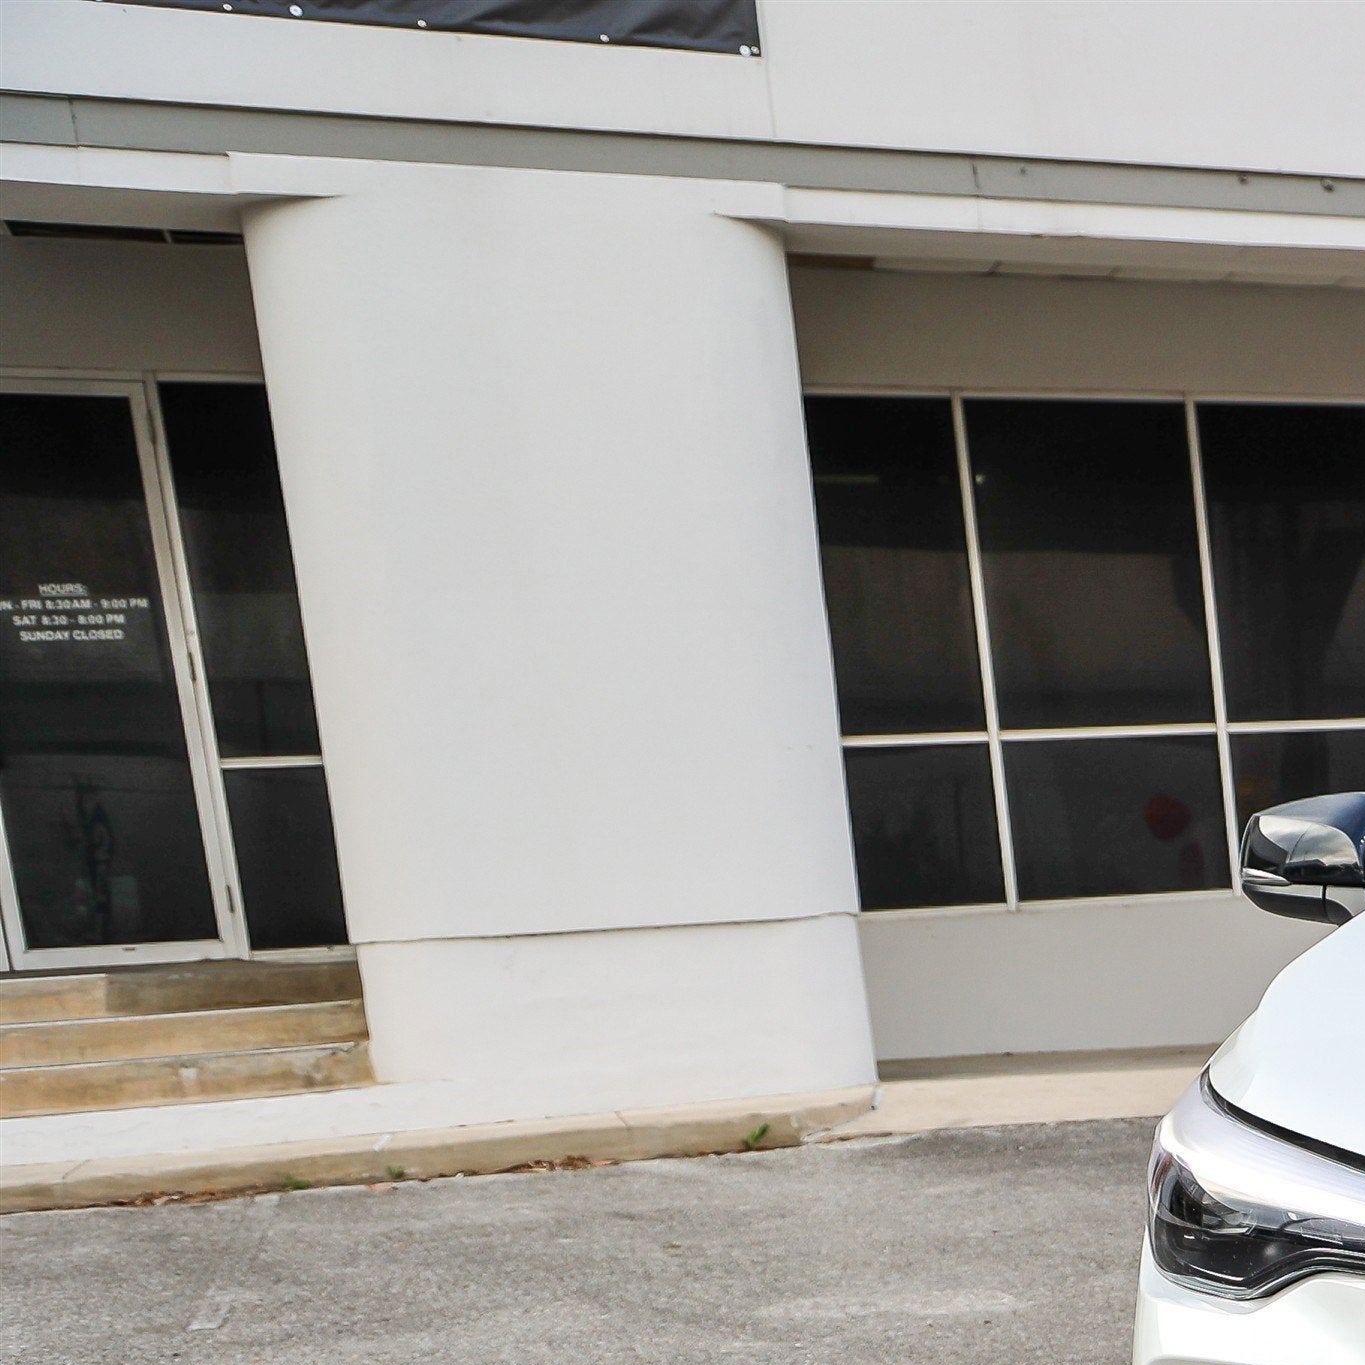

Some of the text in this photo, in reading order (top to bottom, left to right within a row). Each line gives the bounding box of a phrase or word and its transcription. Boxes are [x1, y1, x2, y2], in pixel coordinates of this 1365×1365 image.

[129, 597, 149, 609] PM
[12, 615, 37, 627] SAT
[105, 613, 126, 625] PM
[19, 629, 125, 642] SUNDAY CLOSED
